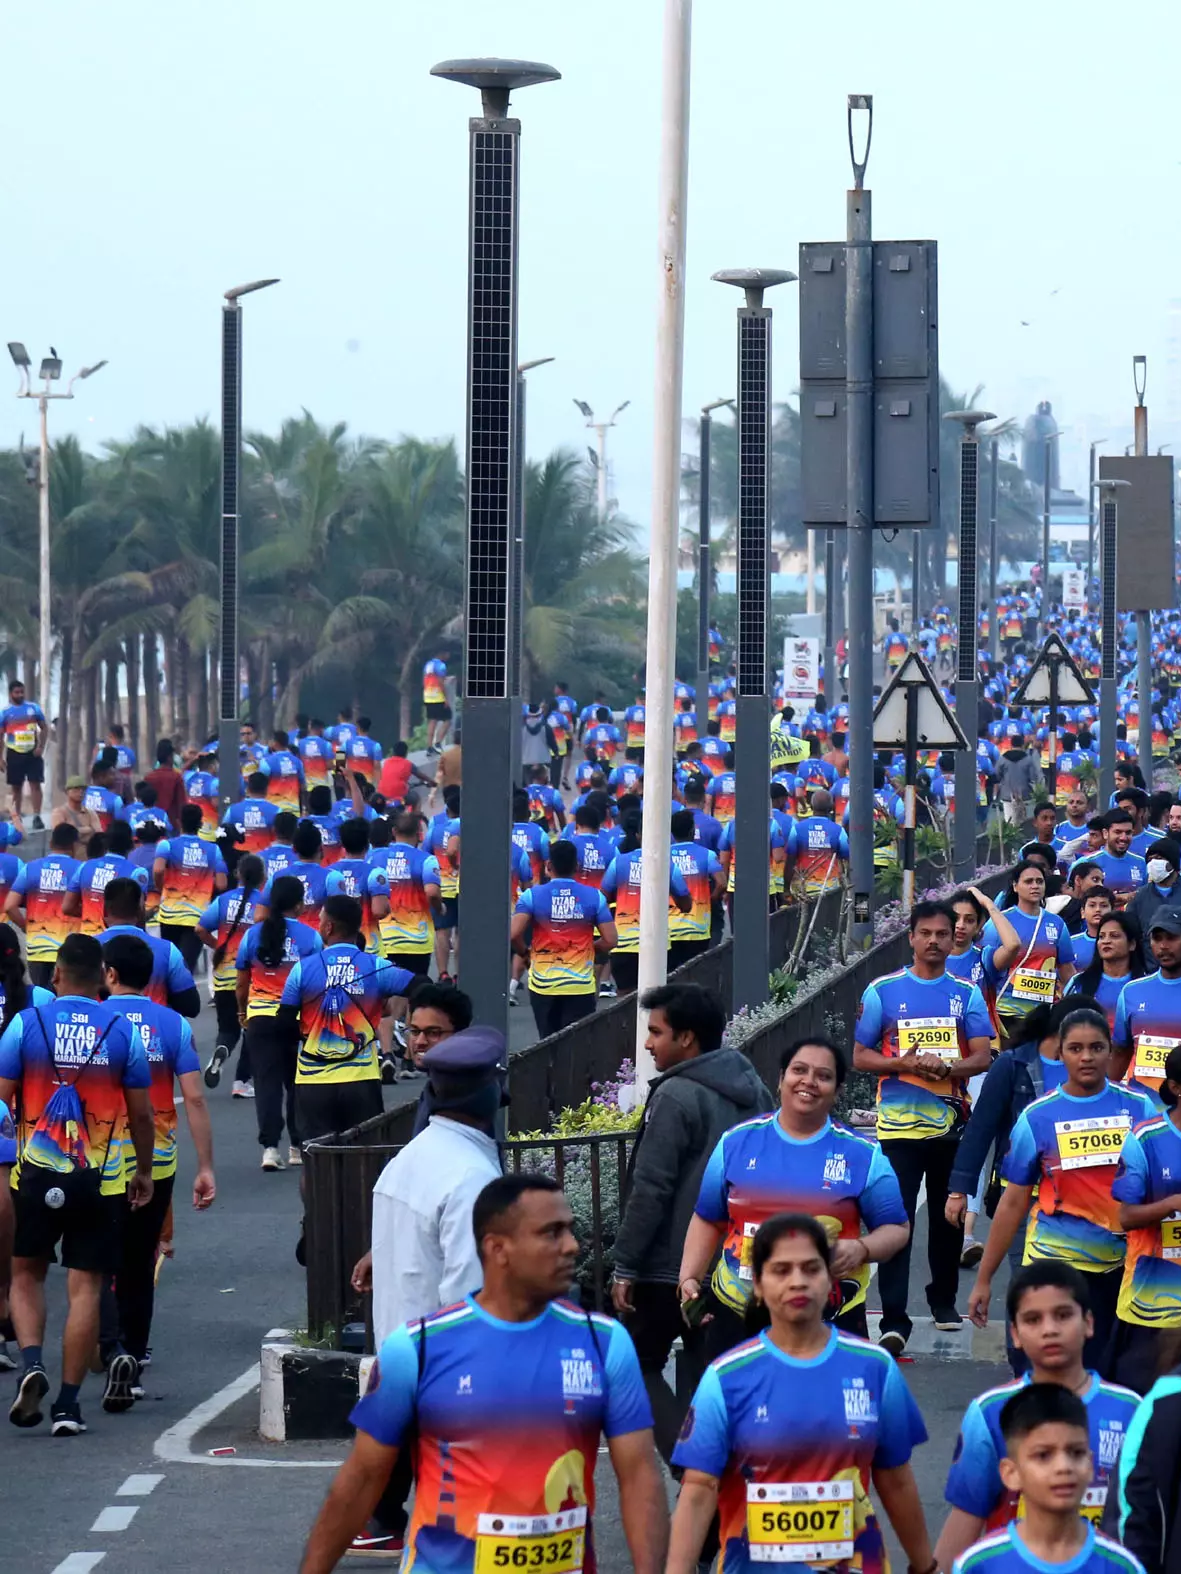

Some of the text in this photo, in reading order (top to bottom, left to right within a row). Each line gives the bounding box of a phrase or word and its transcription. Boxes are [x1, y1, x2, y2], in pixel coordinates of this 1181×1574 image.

[630, 862, 641, 870] VIZ
[41, 868, 64, 877] VIZAG
[40, 877, 62, 888] NAVY
[552, 896, 576, 905] VIZAG
[551, 905, 575, 914] NAVY
[1020, 978, 1051, 991] 50097
[71, 1012, 89, 1023] SBI
[126, 1012, 142, 1023] SBI
[55, 1023, 96, 1040] VIZAG
[908, 1031, 951, 1044] 52690
[54, 1038, 95, 1056] NAVY
[148, 1053, 164, 1063] 2024
[1145, 1050, 1170, 1062] 538
[1069, 1134, 1123, 1151] 57068
[762, 1510, 840, 1533] 56007
[493, 1538, 573, 1567] 56332
